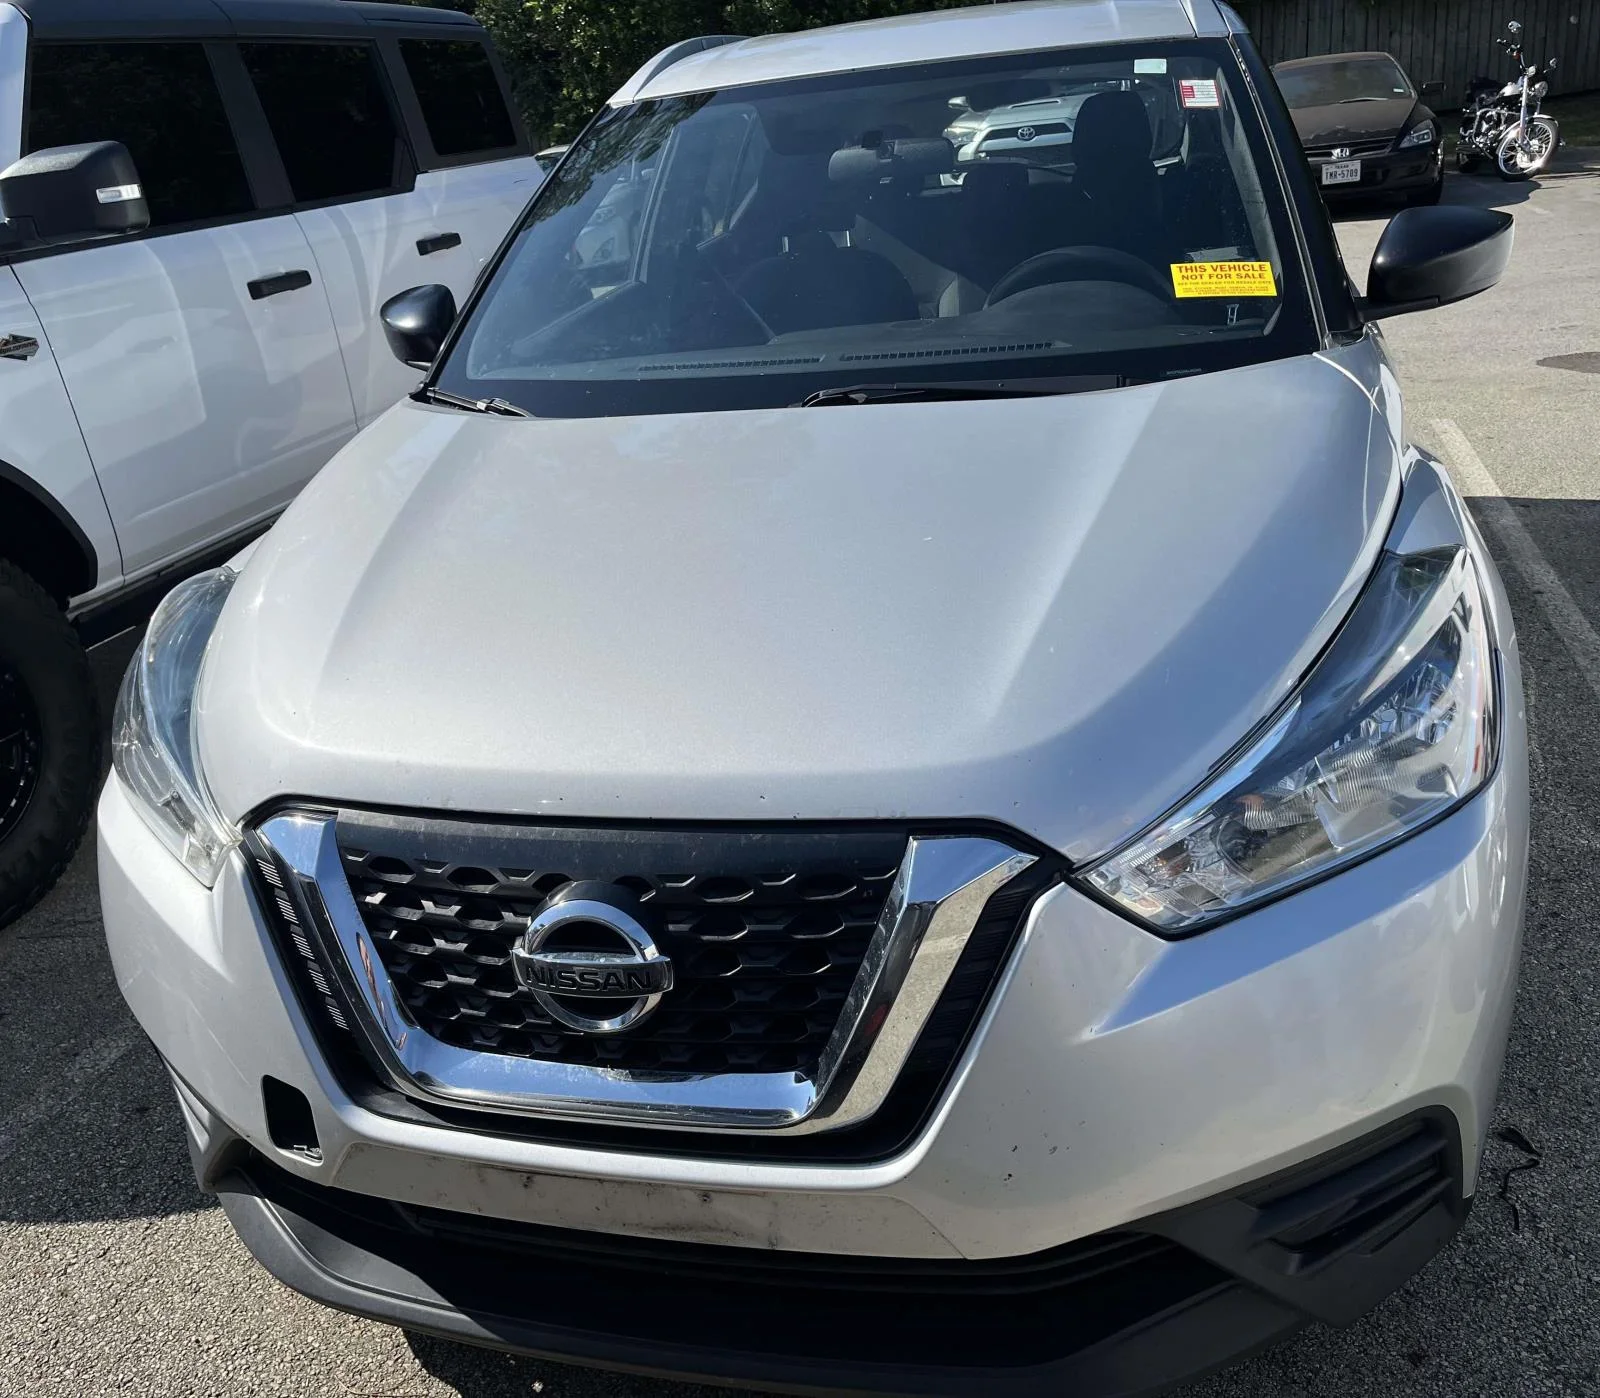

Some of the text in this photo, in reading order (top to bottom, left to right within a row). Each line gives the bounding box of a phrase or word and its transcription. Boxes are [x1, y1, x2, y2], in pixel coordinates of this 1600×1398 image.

[1176, 264, 1267, 273] THIS VEHICLE
[1181, 273, 1204, 281] NOT
[1235, 272, 1265, 280] SALE
[526, 966, 652, 992] NISSAN
